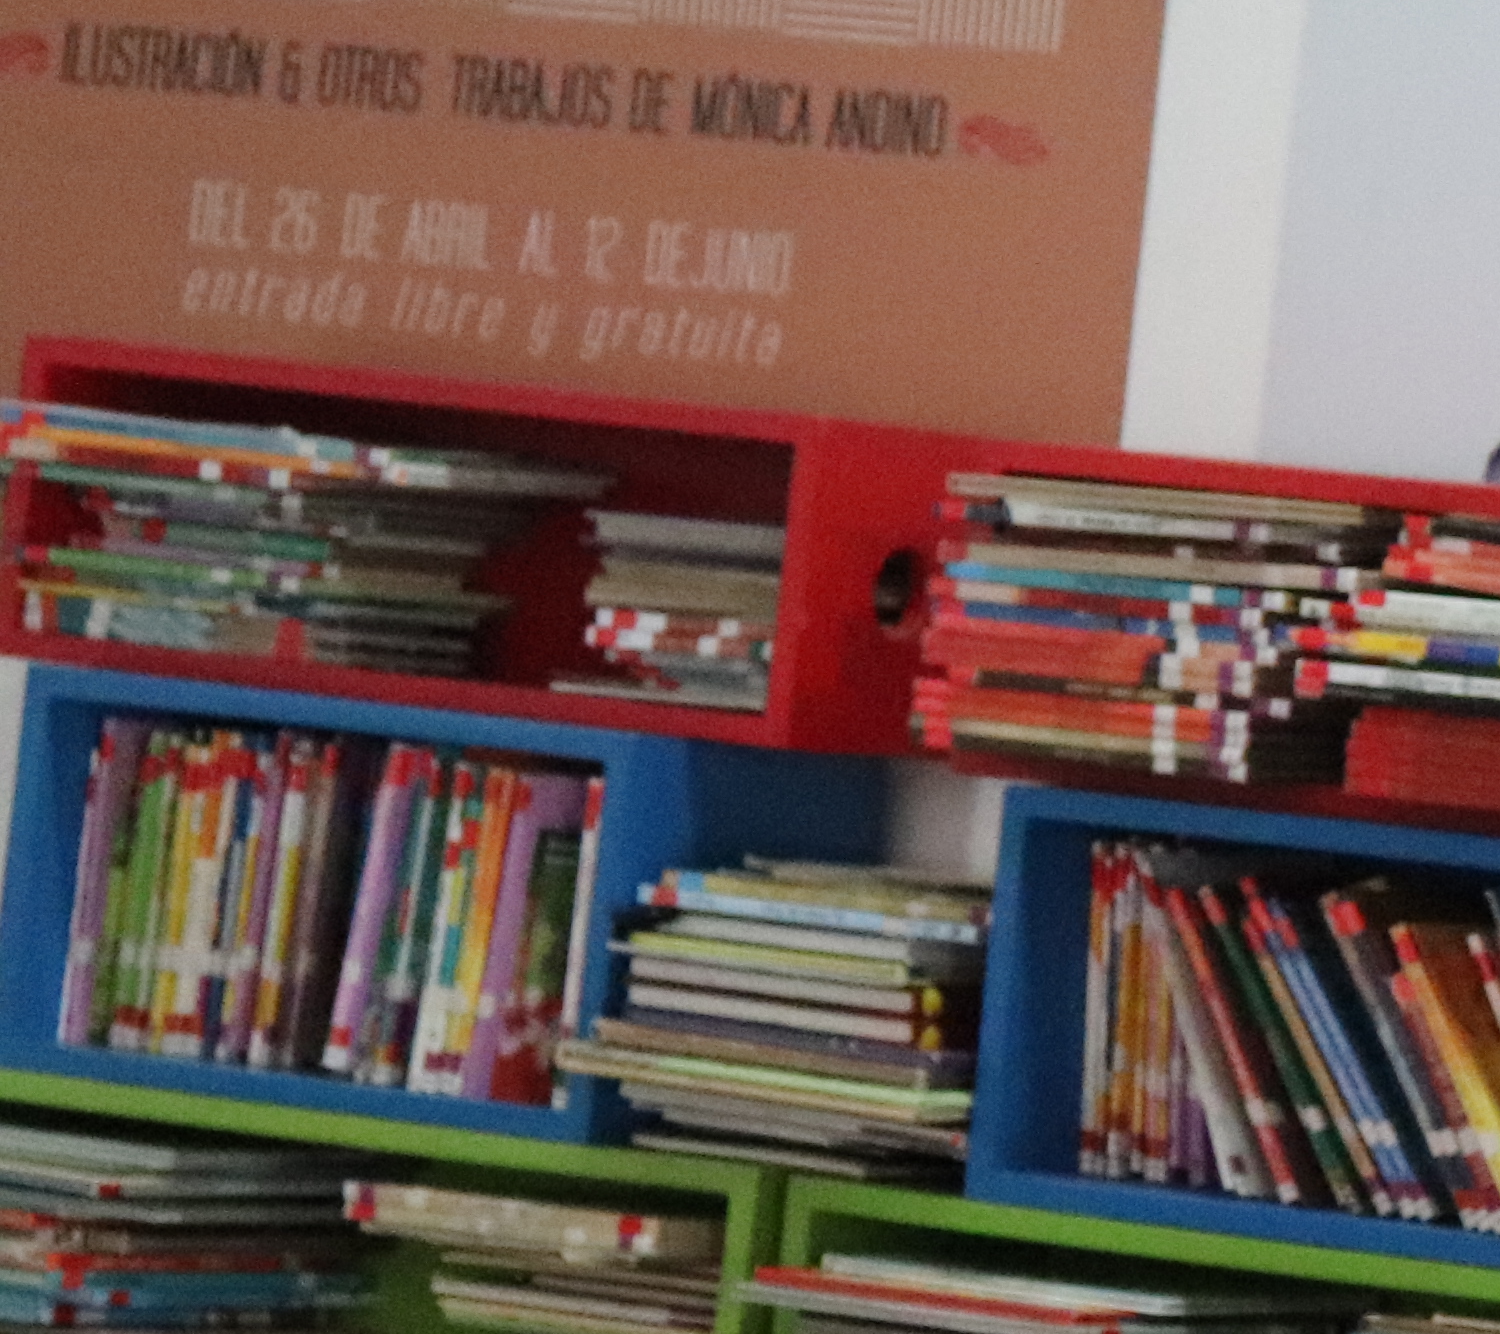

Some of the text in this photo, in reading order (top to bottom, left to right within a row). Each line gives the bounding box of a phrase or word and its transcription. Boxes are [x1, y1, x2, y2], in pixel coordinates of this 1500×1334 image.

[58, 21, 268, 99] ILUSTRACIÓN
[316, 40, 424, 115] OTROS
[450, 51, 613, 130] TRABAJOS
[628, 68, 674, 134] DE
[690, 72, 812, 147] MÓNICA
[823, 85, 950, 158] ANDINO
[188, 178, 248, 250] DEL
[340, 190, 388, 263] DE
[400, 198, 491, 271] ABRIL
[518, 209, 556, 279] AL
[643, 220, 692, 289] DE
[690, 227, 797, 299] JUNIO
[180, 267, 785, 367] entrada libre y gratuita
